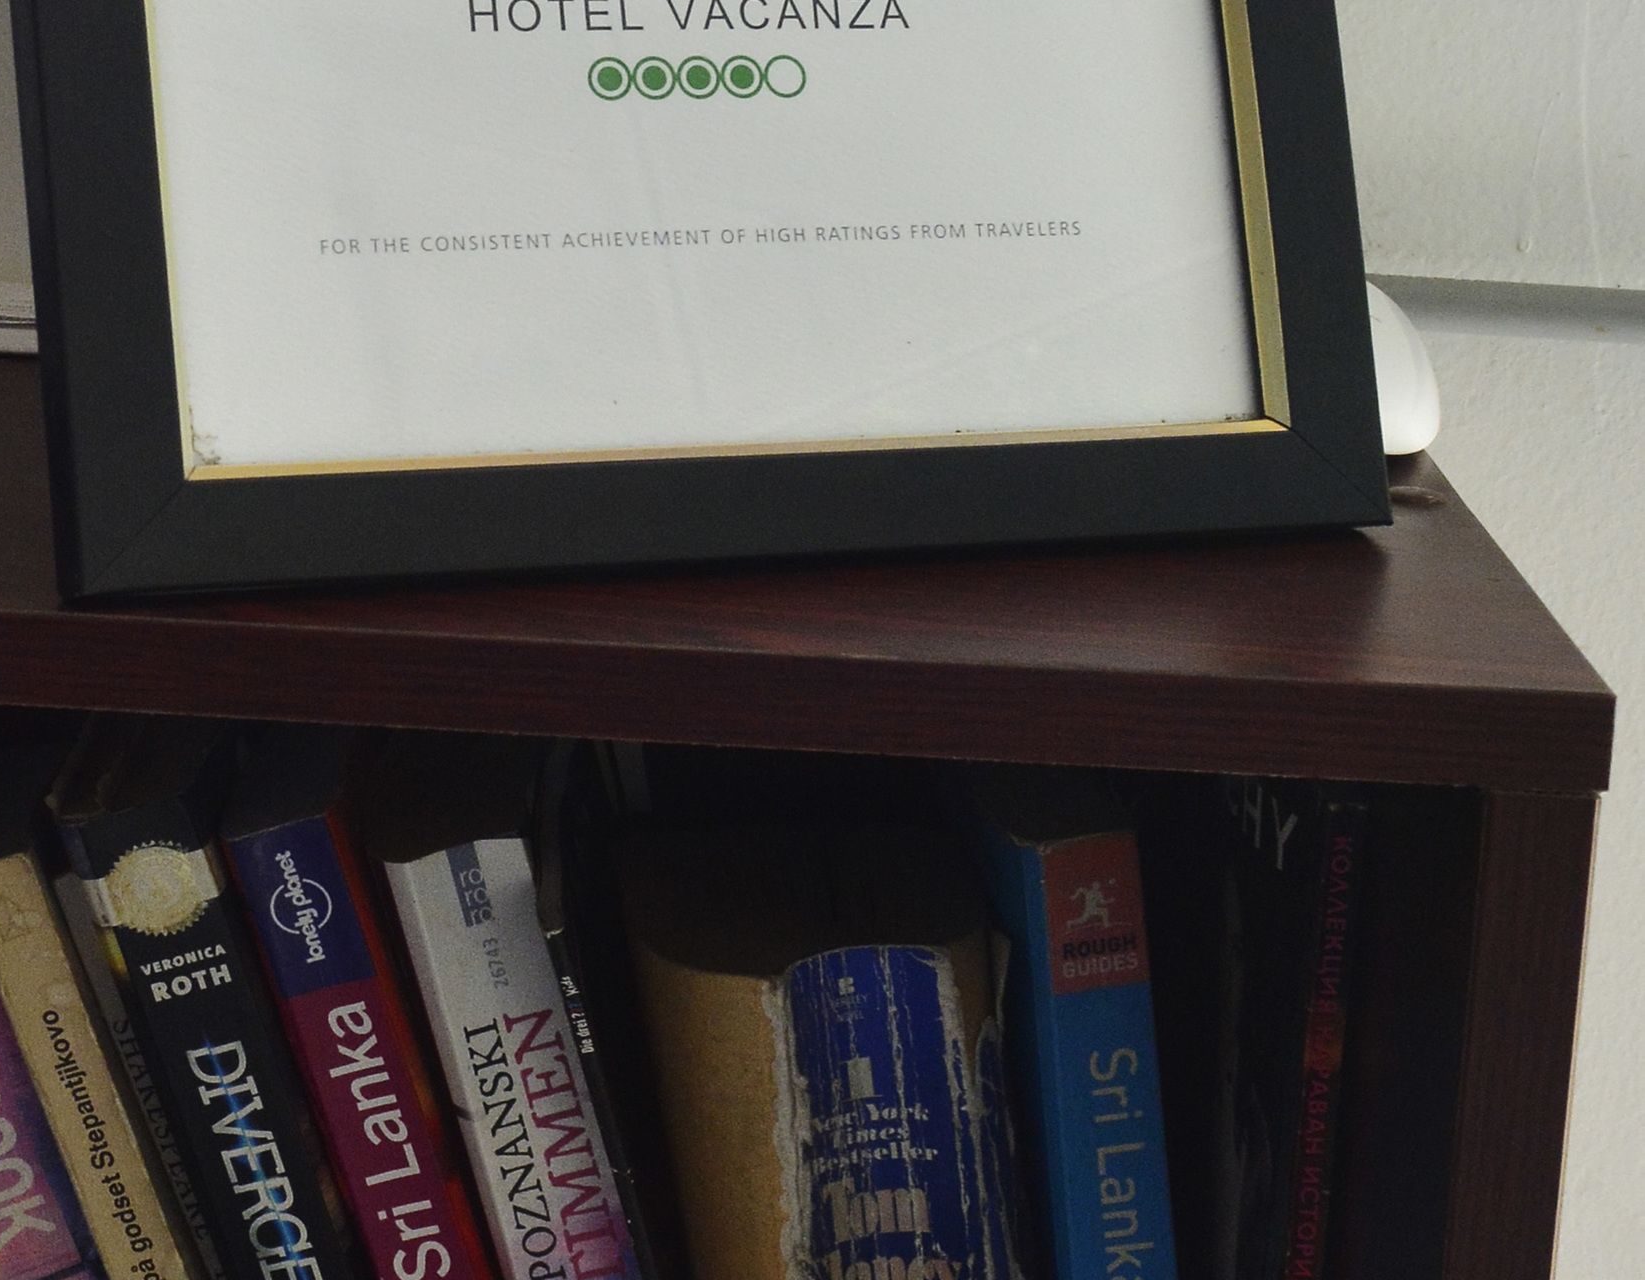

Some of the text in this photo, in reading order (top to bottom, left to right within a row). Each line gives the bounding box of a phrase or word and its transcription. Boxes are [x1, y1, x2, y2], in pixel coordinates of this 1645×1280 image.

[319, 220, 1082, 255] FOR THE CONSISTENT ACHIEVEMENT OF HIGH RATINGS FROM TRAVELERS
[274, 849, 326, 964] lonely planet
[140, 943, 227, 977] VERONICA
[483, 936, 510, 990] 26743
[1061, 933, 1138, 960] ROUGH
[1061, 952, 1139, 980] GUIDES
[150, 963, 233, 1004] ROTH
[42, 1009, 116, 1172] Stepantjikovo
[327, 999, 422, 1187] Lanka
[1088, 1046, 1144, 1125] Sri
[866, 1100, 932, 1122] York
[100, 1172, 153, 1254] godset
